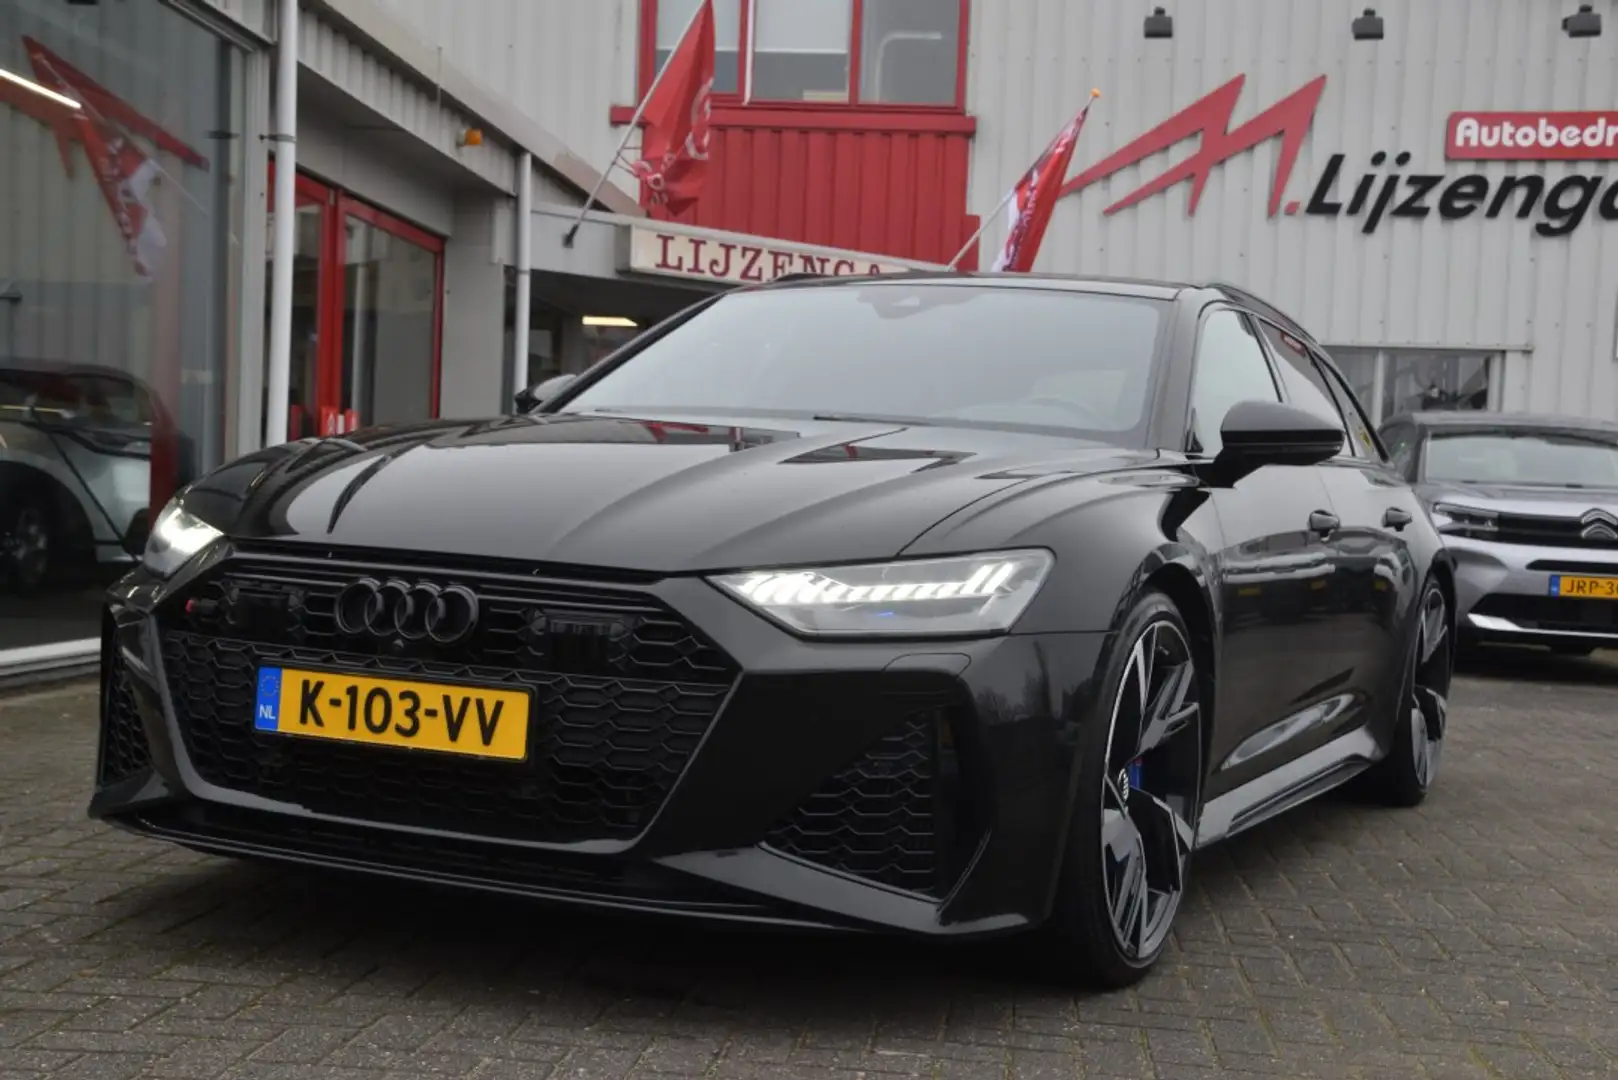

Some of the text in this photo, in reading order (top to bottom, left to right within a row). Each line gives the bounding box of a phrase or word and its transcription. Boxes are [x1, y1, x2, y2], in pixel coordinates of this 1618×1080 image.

[1455, 117, 1618, 147] Autobedr
[1565, 579, 1618, 595] JRP-3
[259, 704, 276, 720] NL
[300, 679, 504, 746] K-103-VV
